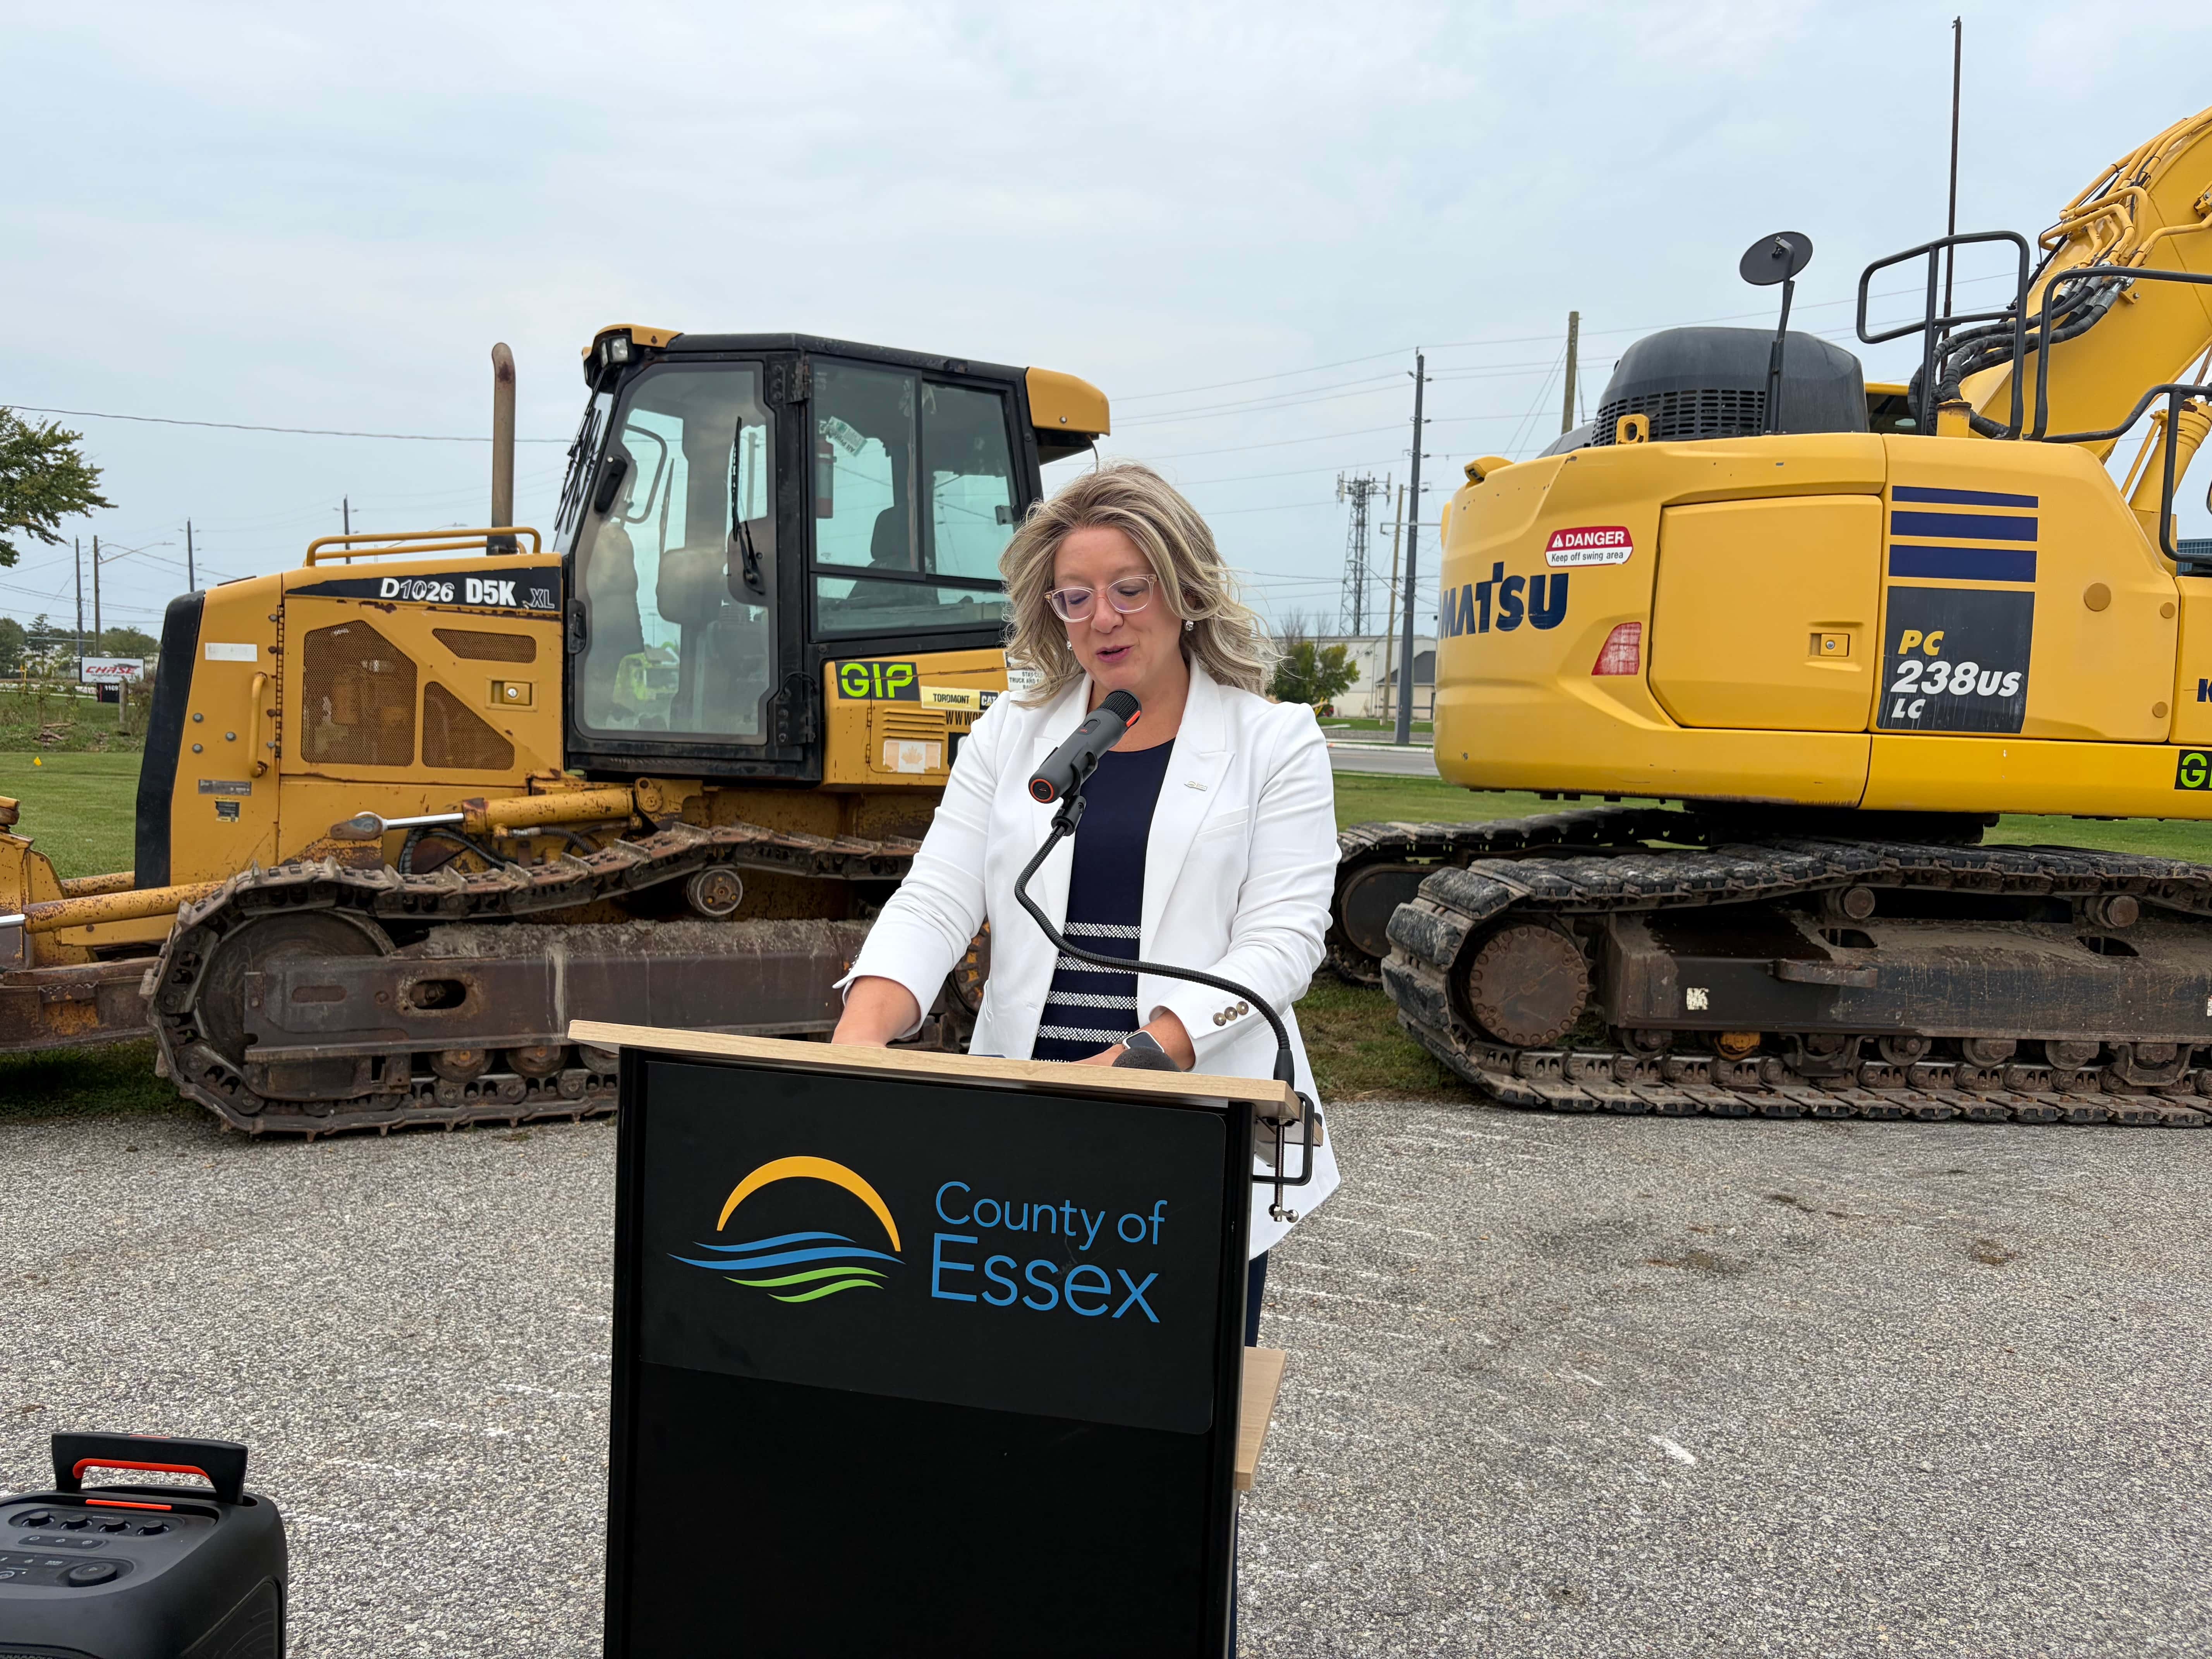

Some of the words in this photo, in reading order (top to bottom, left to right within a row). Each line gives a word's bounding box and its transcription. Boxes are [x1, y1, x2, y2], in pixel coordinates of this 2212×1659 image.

[1565, 531, 1625, 547] DANGER
[1551, 553, 1568, 563] Keep
[1571, 551, 1580, 561] off
[1582, 551, 1604, 562] swing
[380, 578, 455, 602] D1026
[466, 577, 517, 606] D5K
[529, 587, 555, 609] XL
[1898, 630, 1944, 656] PC
[86, 666, 137, 674] CHASE
[841, 663, 913, 698] GIP
[933, 693, 970, 704] TOROMONT
[981, 696, 997, 706] CAT
[1891, 699, 1926, 719] LC
[935, 1180, 1106, 1251] County
[1117, 1199, 1168, 1245] of
[931, 1232, 1160, 1323] Essex
